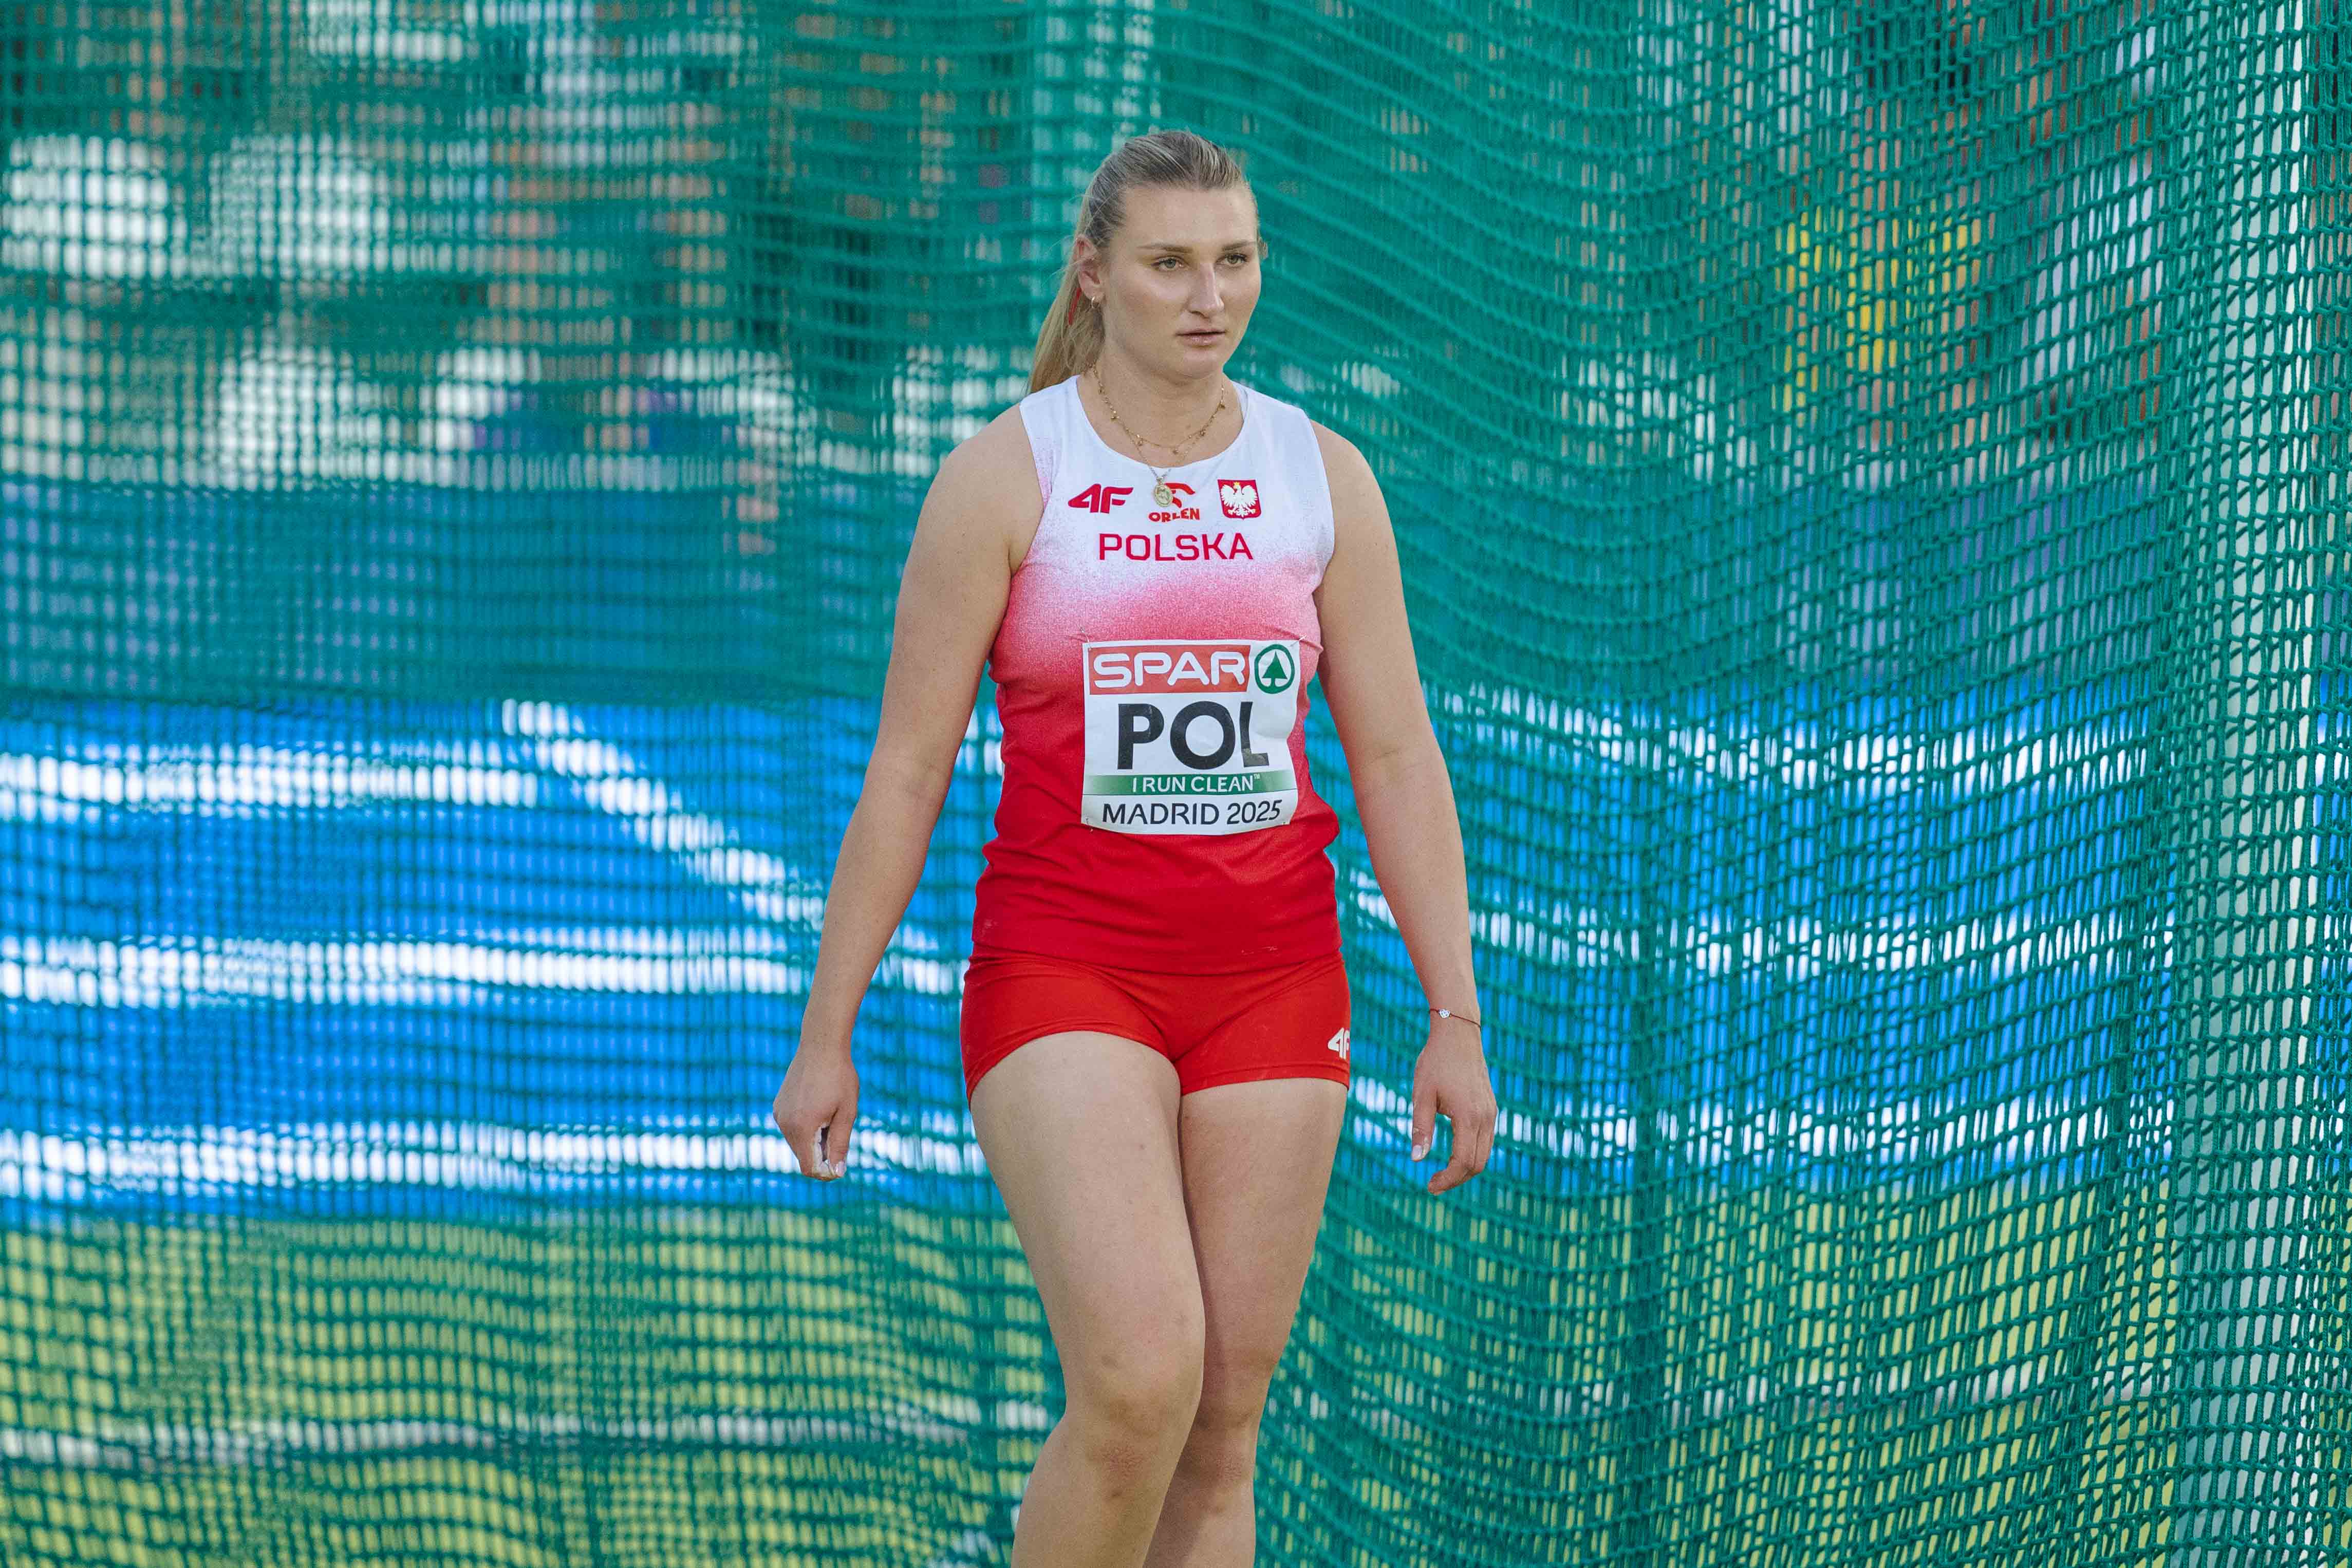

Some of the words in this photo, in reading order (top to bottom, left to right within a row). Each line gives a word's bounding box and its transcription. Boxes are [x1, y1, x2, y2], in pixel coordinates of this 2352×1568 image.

[1068, 483, 1133, 514] 4F
[1148, 508, 1200, 522] ORLEN
[1099, 532, 1254, 561] POLSKA
[1093, 651, 1246, 688] SPAR
[1117, 701, 1270, 770] POL
[1132, 776, 1138, 792] I
[1143, 776, 1186, 792] RUN
[1102, 802, 1219, 825] MADRID
[1227, 799, 1282, 825] 2025
